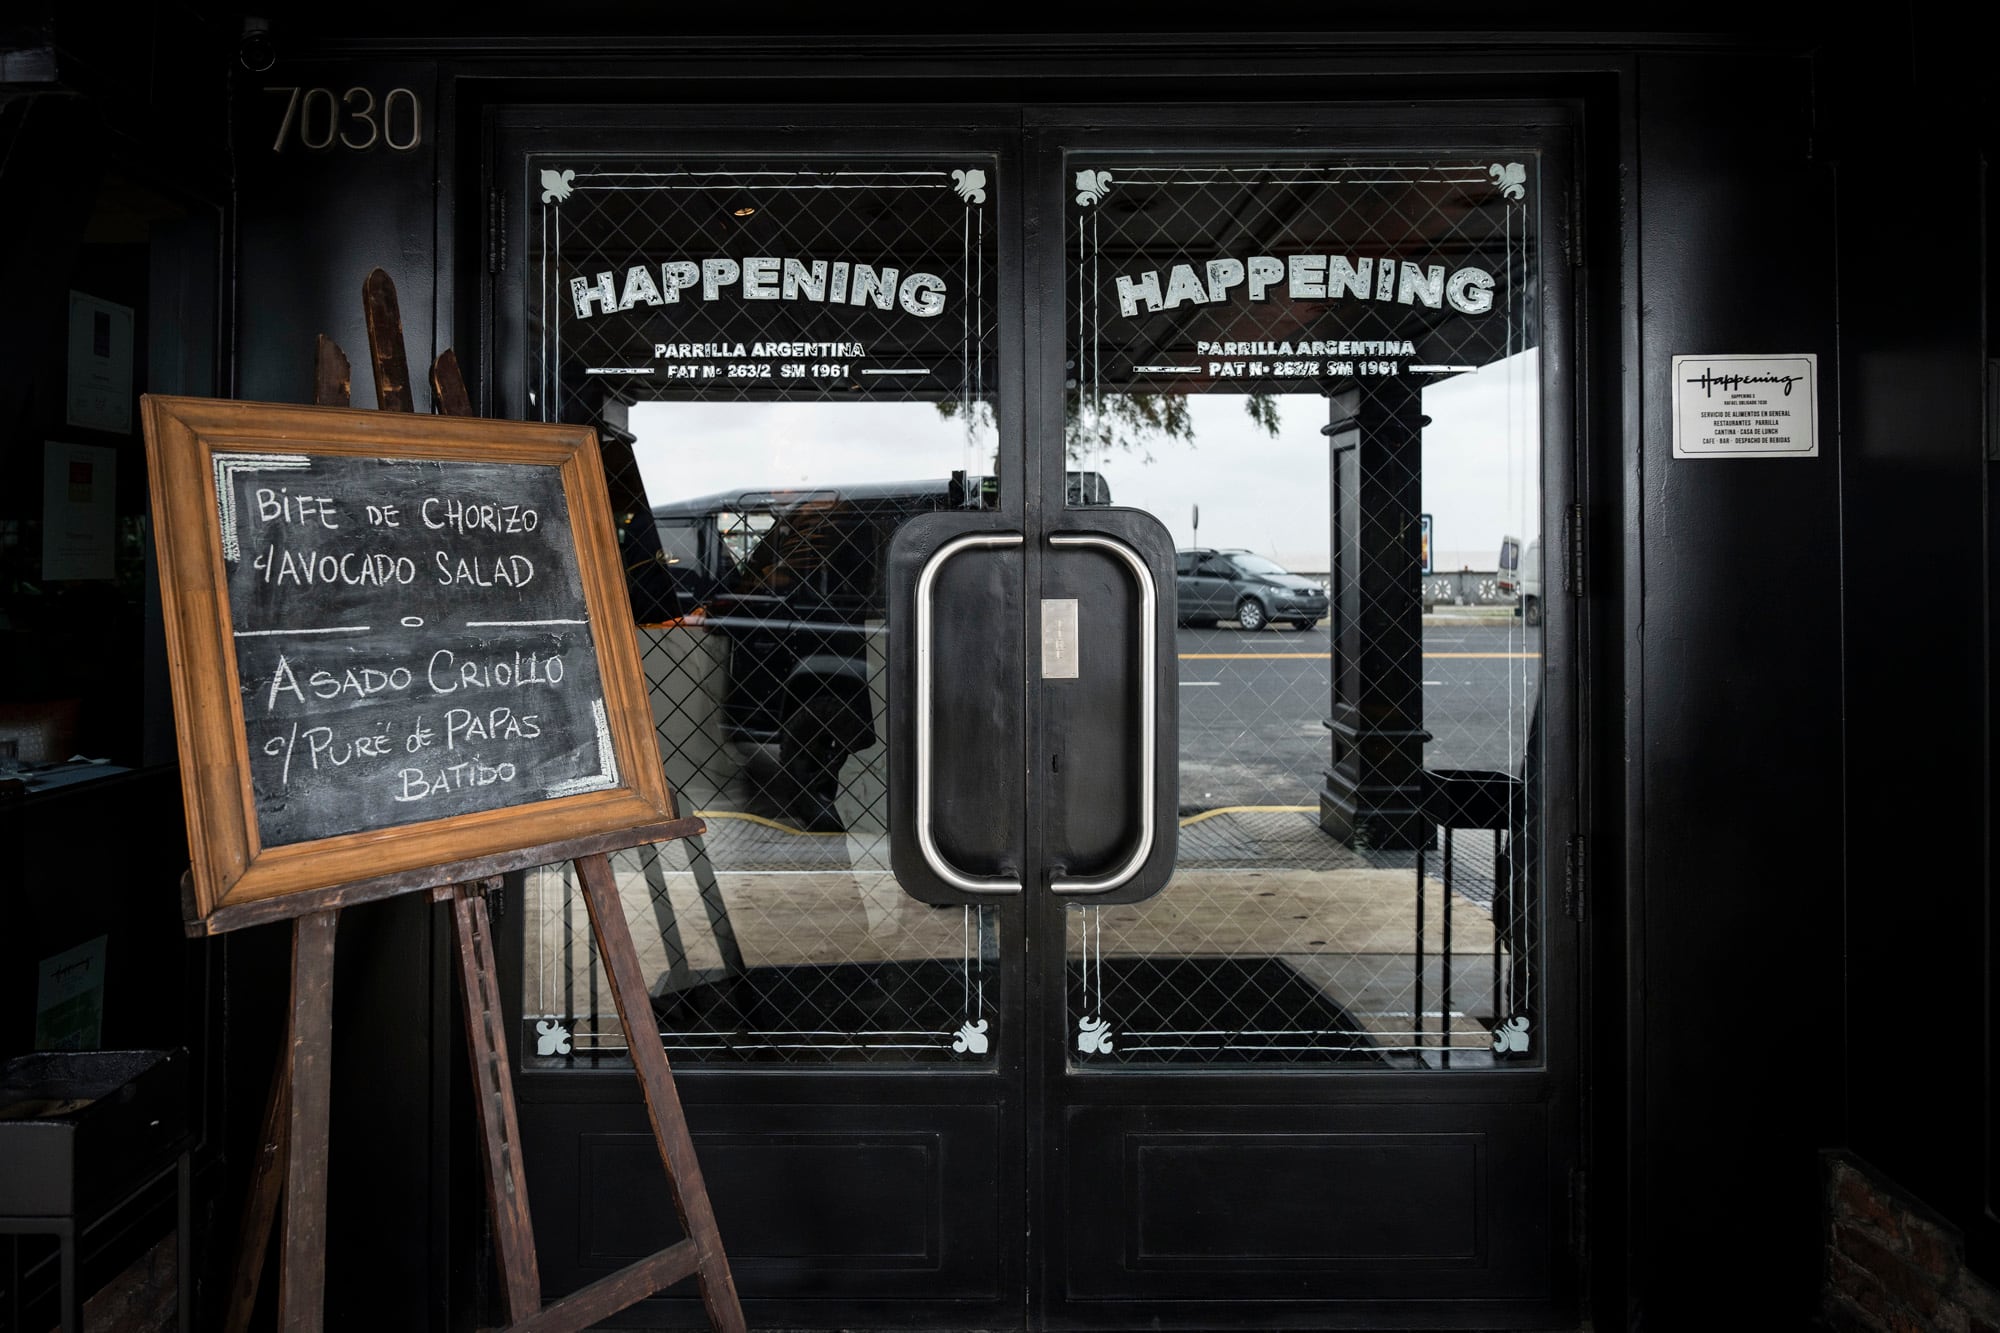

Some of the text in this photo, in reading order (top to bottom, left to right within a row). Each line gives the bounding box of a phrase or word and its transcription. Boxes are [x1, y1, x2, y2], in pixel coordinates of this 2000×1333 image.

[263, 87, 420, 152] 7030
[570, 257, 947, 319] HAPPENING
[1115, 255, 1496, 317] HAPPENING
[654, 342, 866, 358] PARRILLA ARGENTINA
[1197, 341, 1416, 356] PARRILLA ARGENTINA
[811, 364, 850, 378] 1961
[1209, 362, 1246, 376] PAT
[1687, 367, 1803, 398] Happening
[366, 504, 400, 527] DE
[436, 551, 534, 588] SALAD
[268, 649, 563, 713] ASADO CRIOLLO
[444, 707, 541, 749] PAPAS
